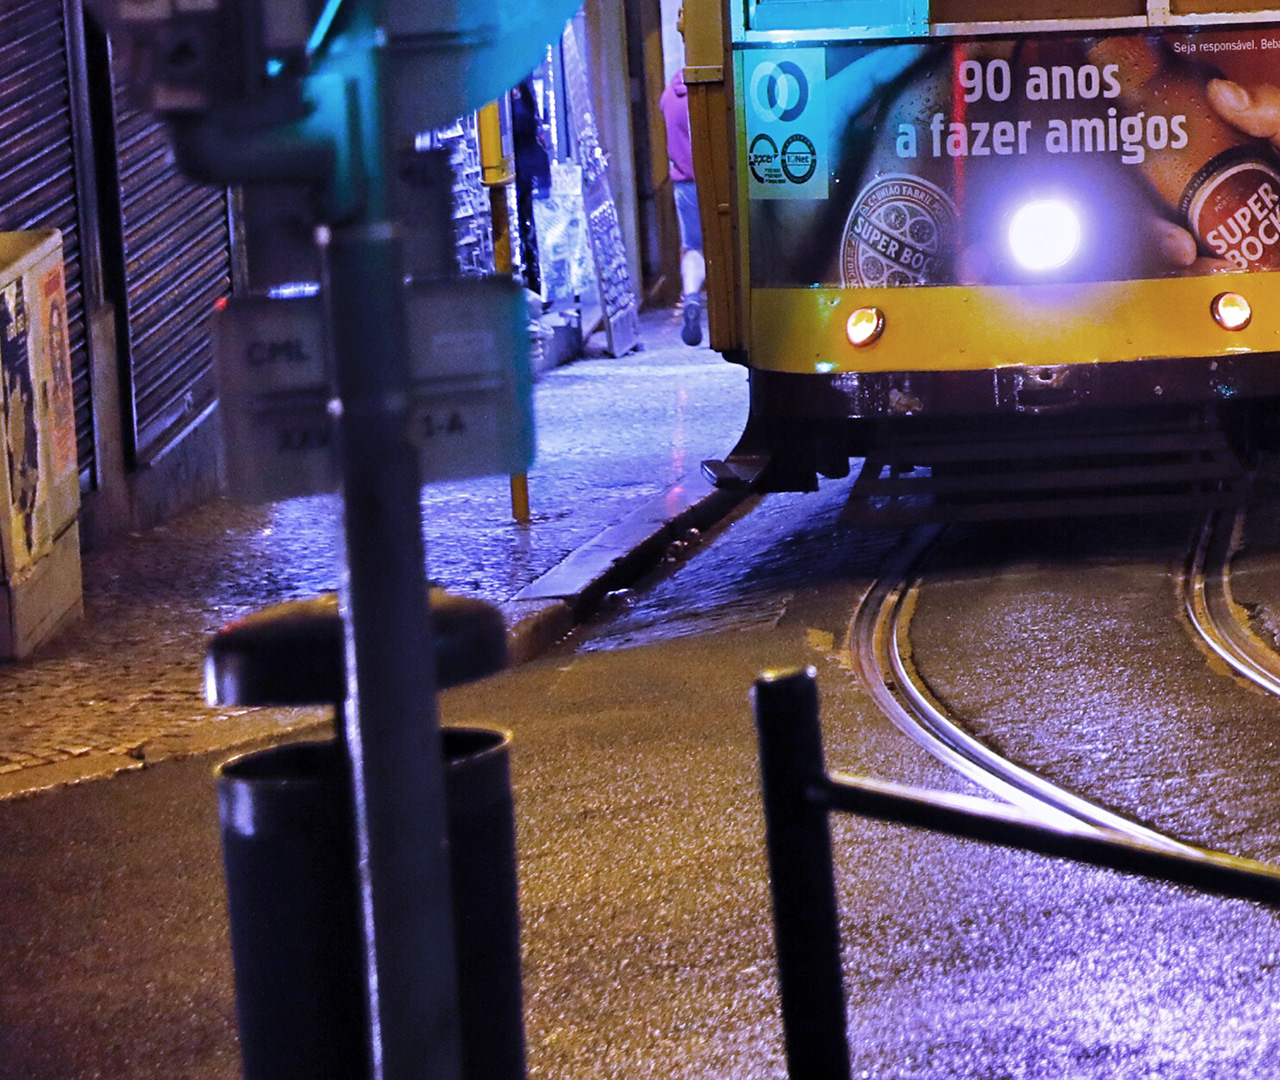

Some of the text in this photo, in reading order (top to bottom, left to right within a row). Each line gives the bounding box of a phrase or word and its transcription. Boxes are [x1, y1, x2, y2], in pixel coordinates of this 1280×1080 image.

[1174, 41, 1197, 54] Seja
[1200, 39, 1258, 53] responsável.
[958, 58, 1121, 103] 90 anos
[895, 107, 1188, 164] a fazer amigos
[853, 215, 900, 259] SUPER
[1206, 182, 1279, 255] SUPER
